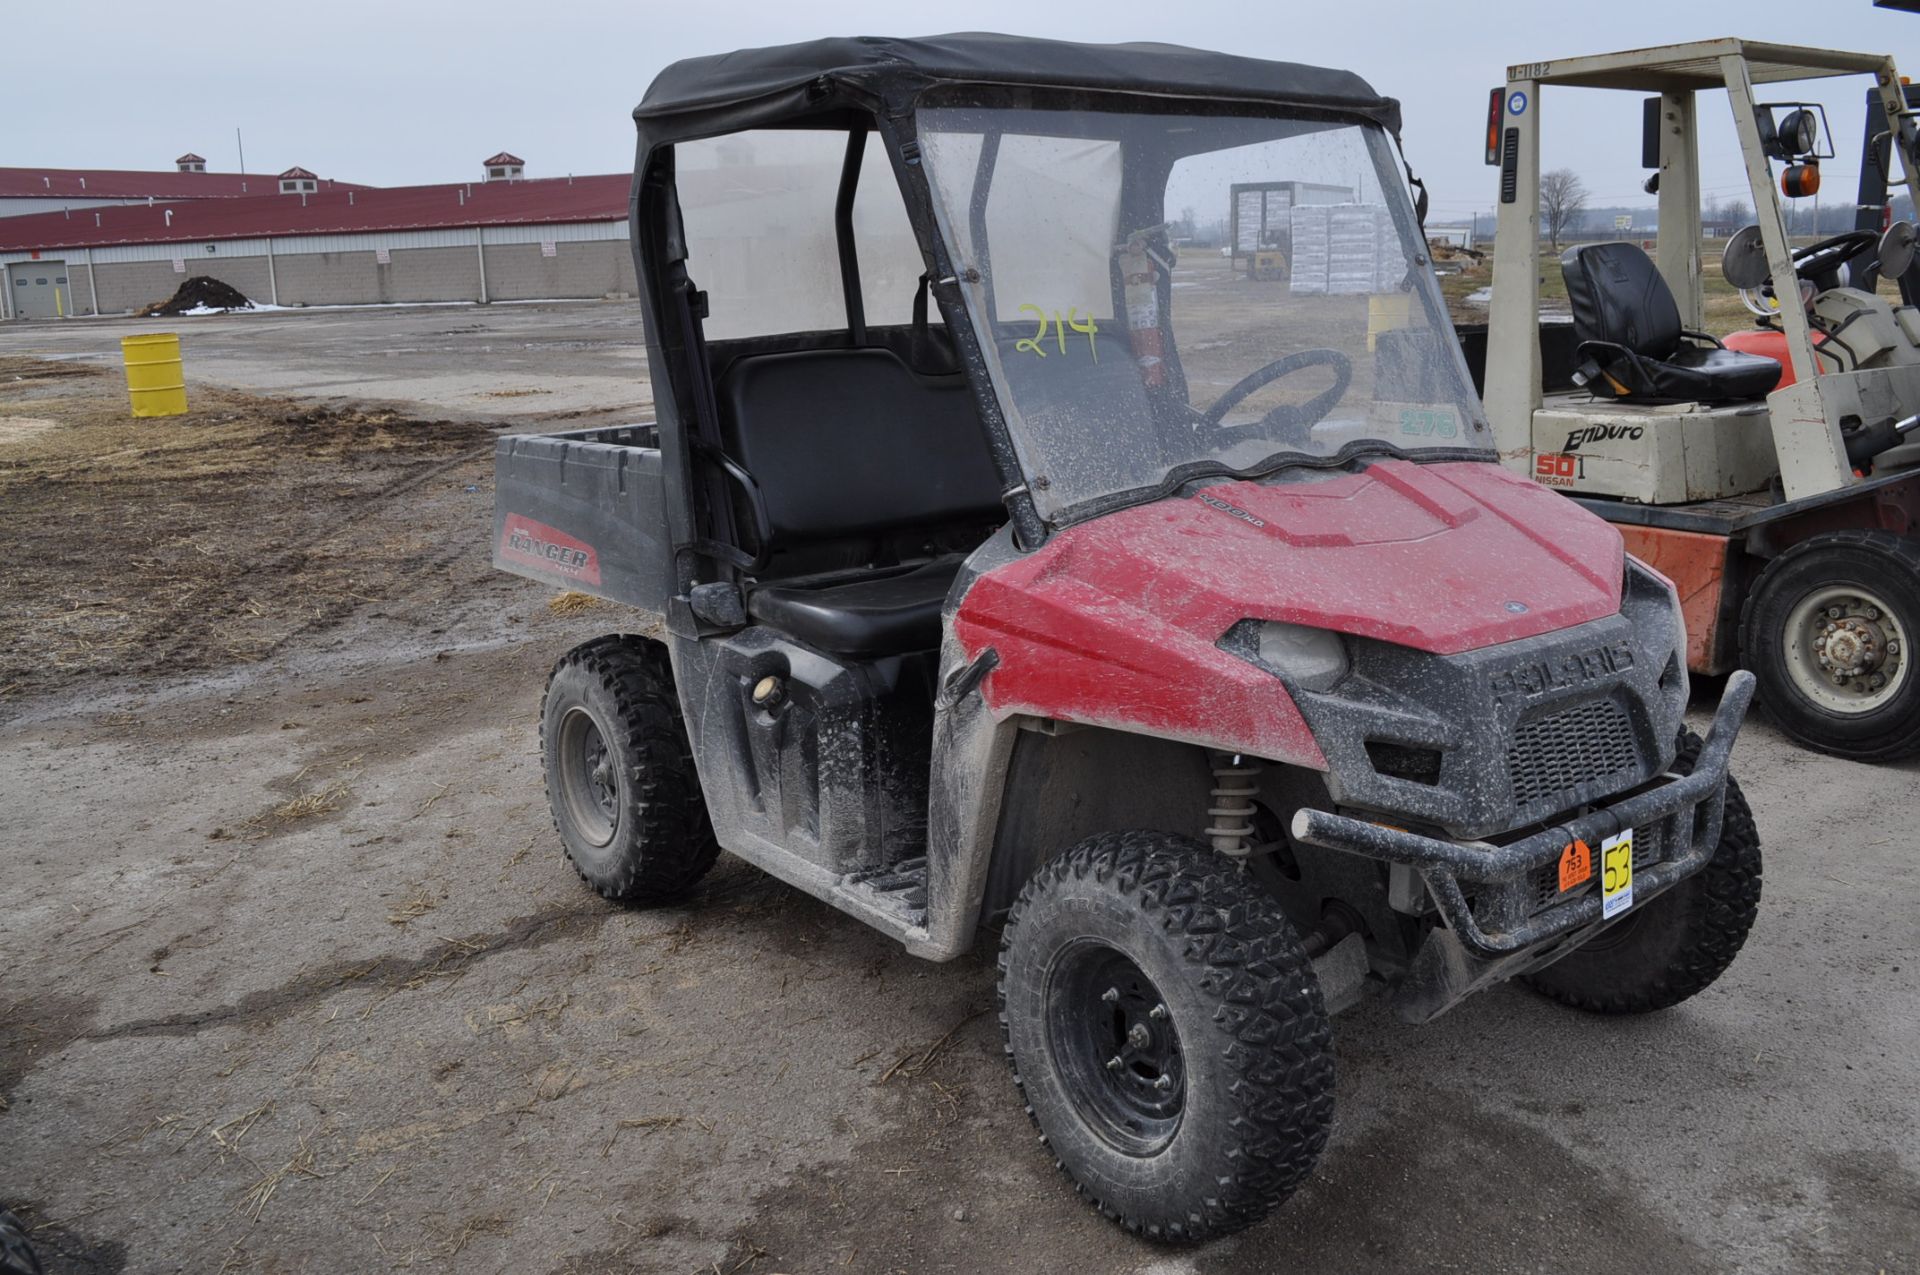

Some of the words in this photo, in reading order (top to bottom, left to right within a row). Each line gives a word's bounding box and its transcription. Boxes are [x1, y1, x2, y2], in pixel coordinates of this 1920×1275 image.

[1015, 303, 1098, 365] 214
[1400, 408, 1458, 439] 276
[1535, 475, 1574, 487] NISSAN
[508, 533, 589, 569] RANGER
[1490, 640, 1634, 705] POLARIS
[1565, 855, 1582, 874] 753
[1604, 843, 1630, 892] 53
